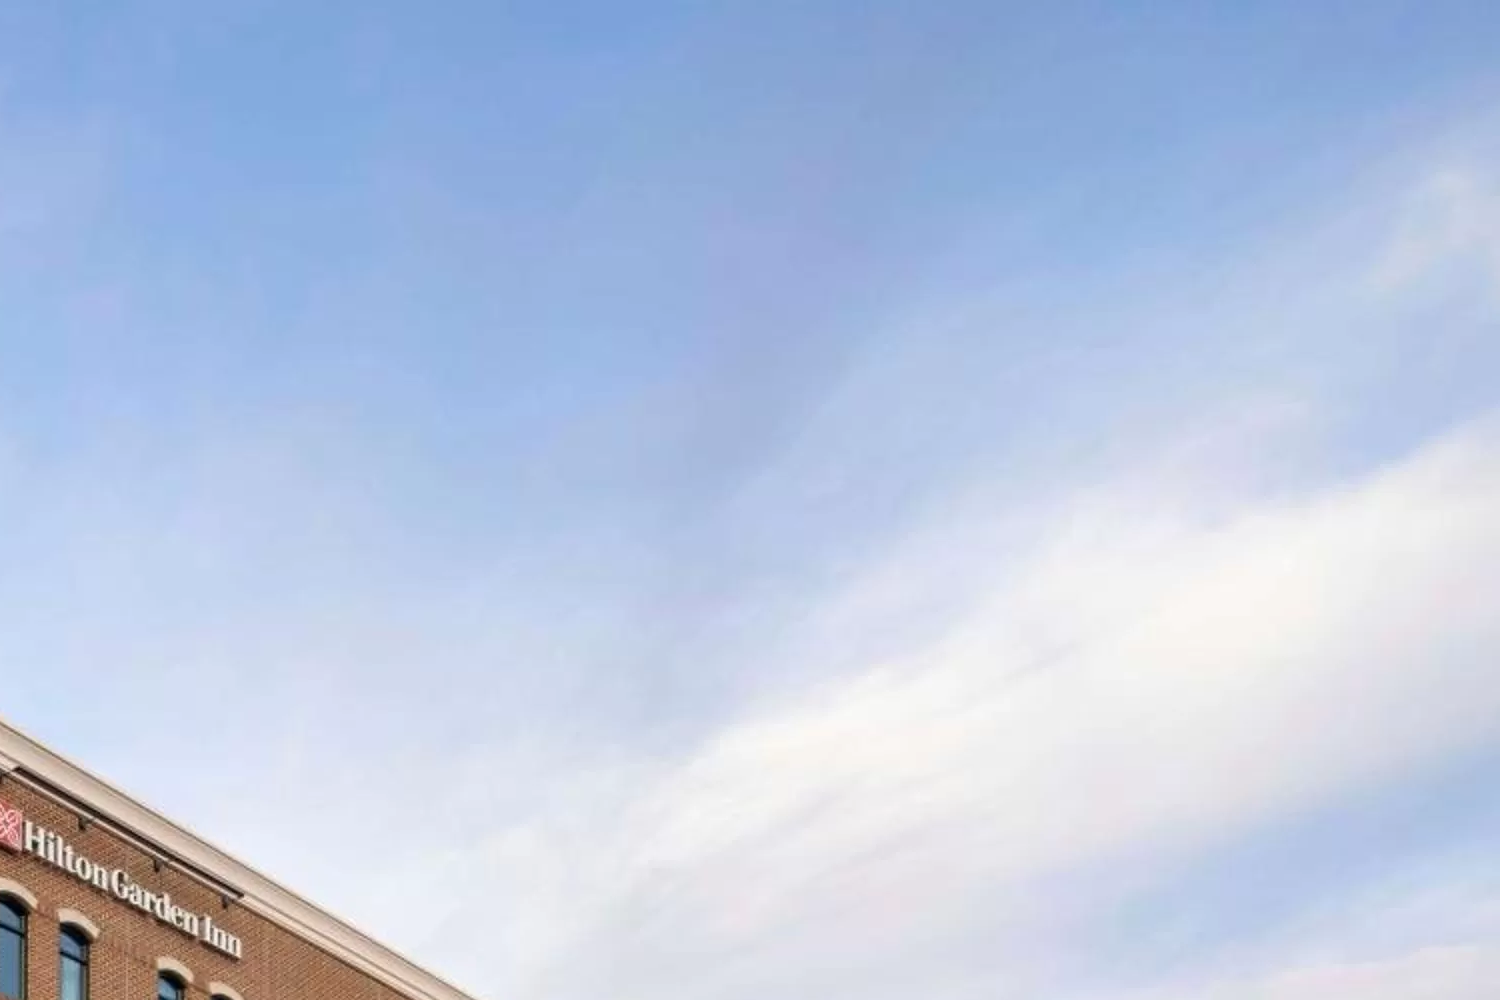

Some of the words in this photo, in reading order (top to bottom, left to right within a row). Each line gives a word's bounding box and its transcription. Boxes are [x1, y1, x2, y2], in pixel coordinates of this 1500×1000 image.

[23, 819, 109, 892] Hilton
[111, 869, 200, 938] Garden
[201, 914, 242, 960] Inn
